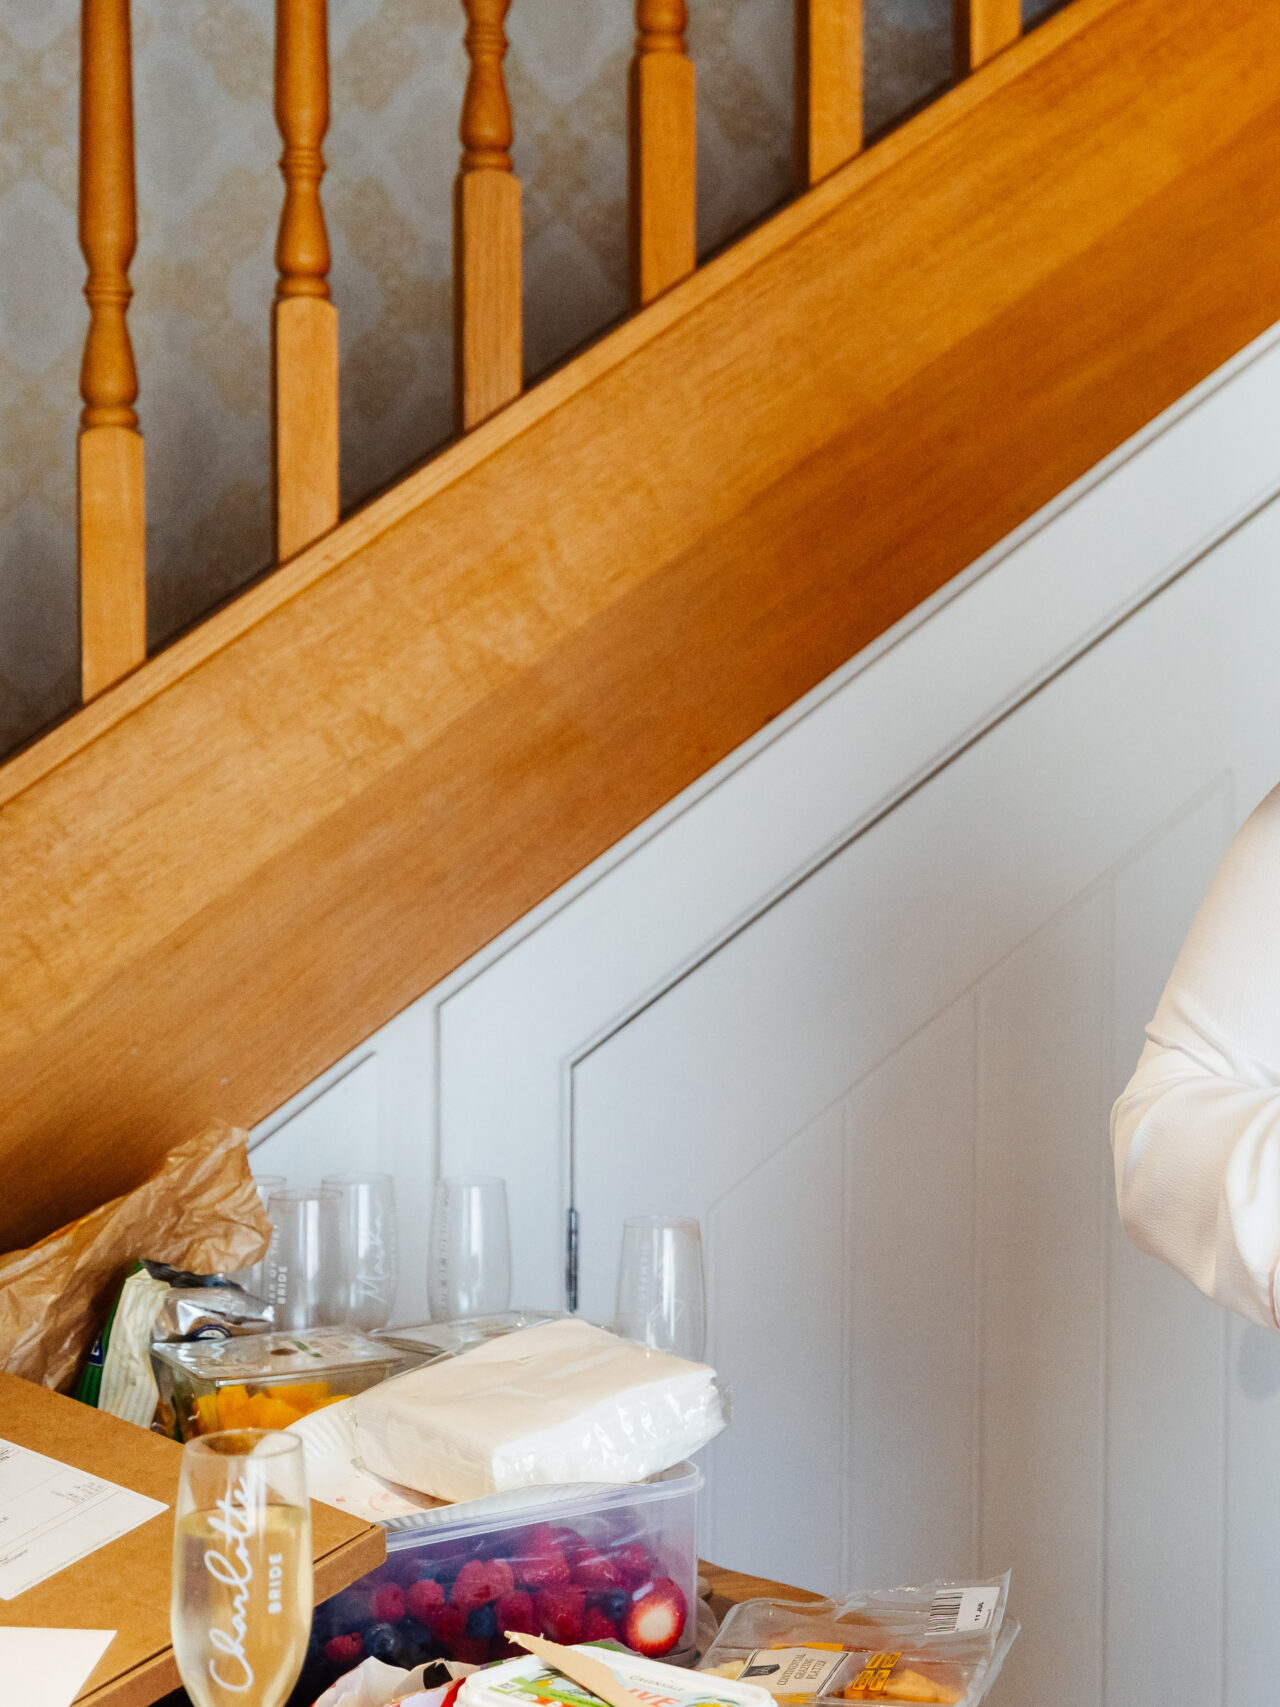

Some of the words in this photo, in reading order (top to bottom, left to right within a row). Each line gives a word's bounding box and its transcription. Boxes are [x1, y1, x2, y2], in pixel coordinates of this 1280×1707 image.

[277, 1266, 288, 1305] BRIDE
[204, 1476, 255, 1692] Charlotte
[268, 1552, 282, 1615] BRIDE
[974, 1614, 981, 1622] 11
